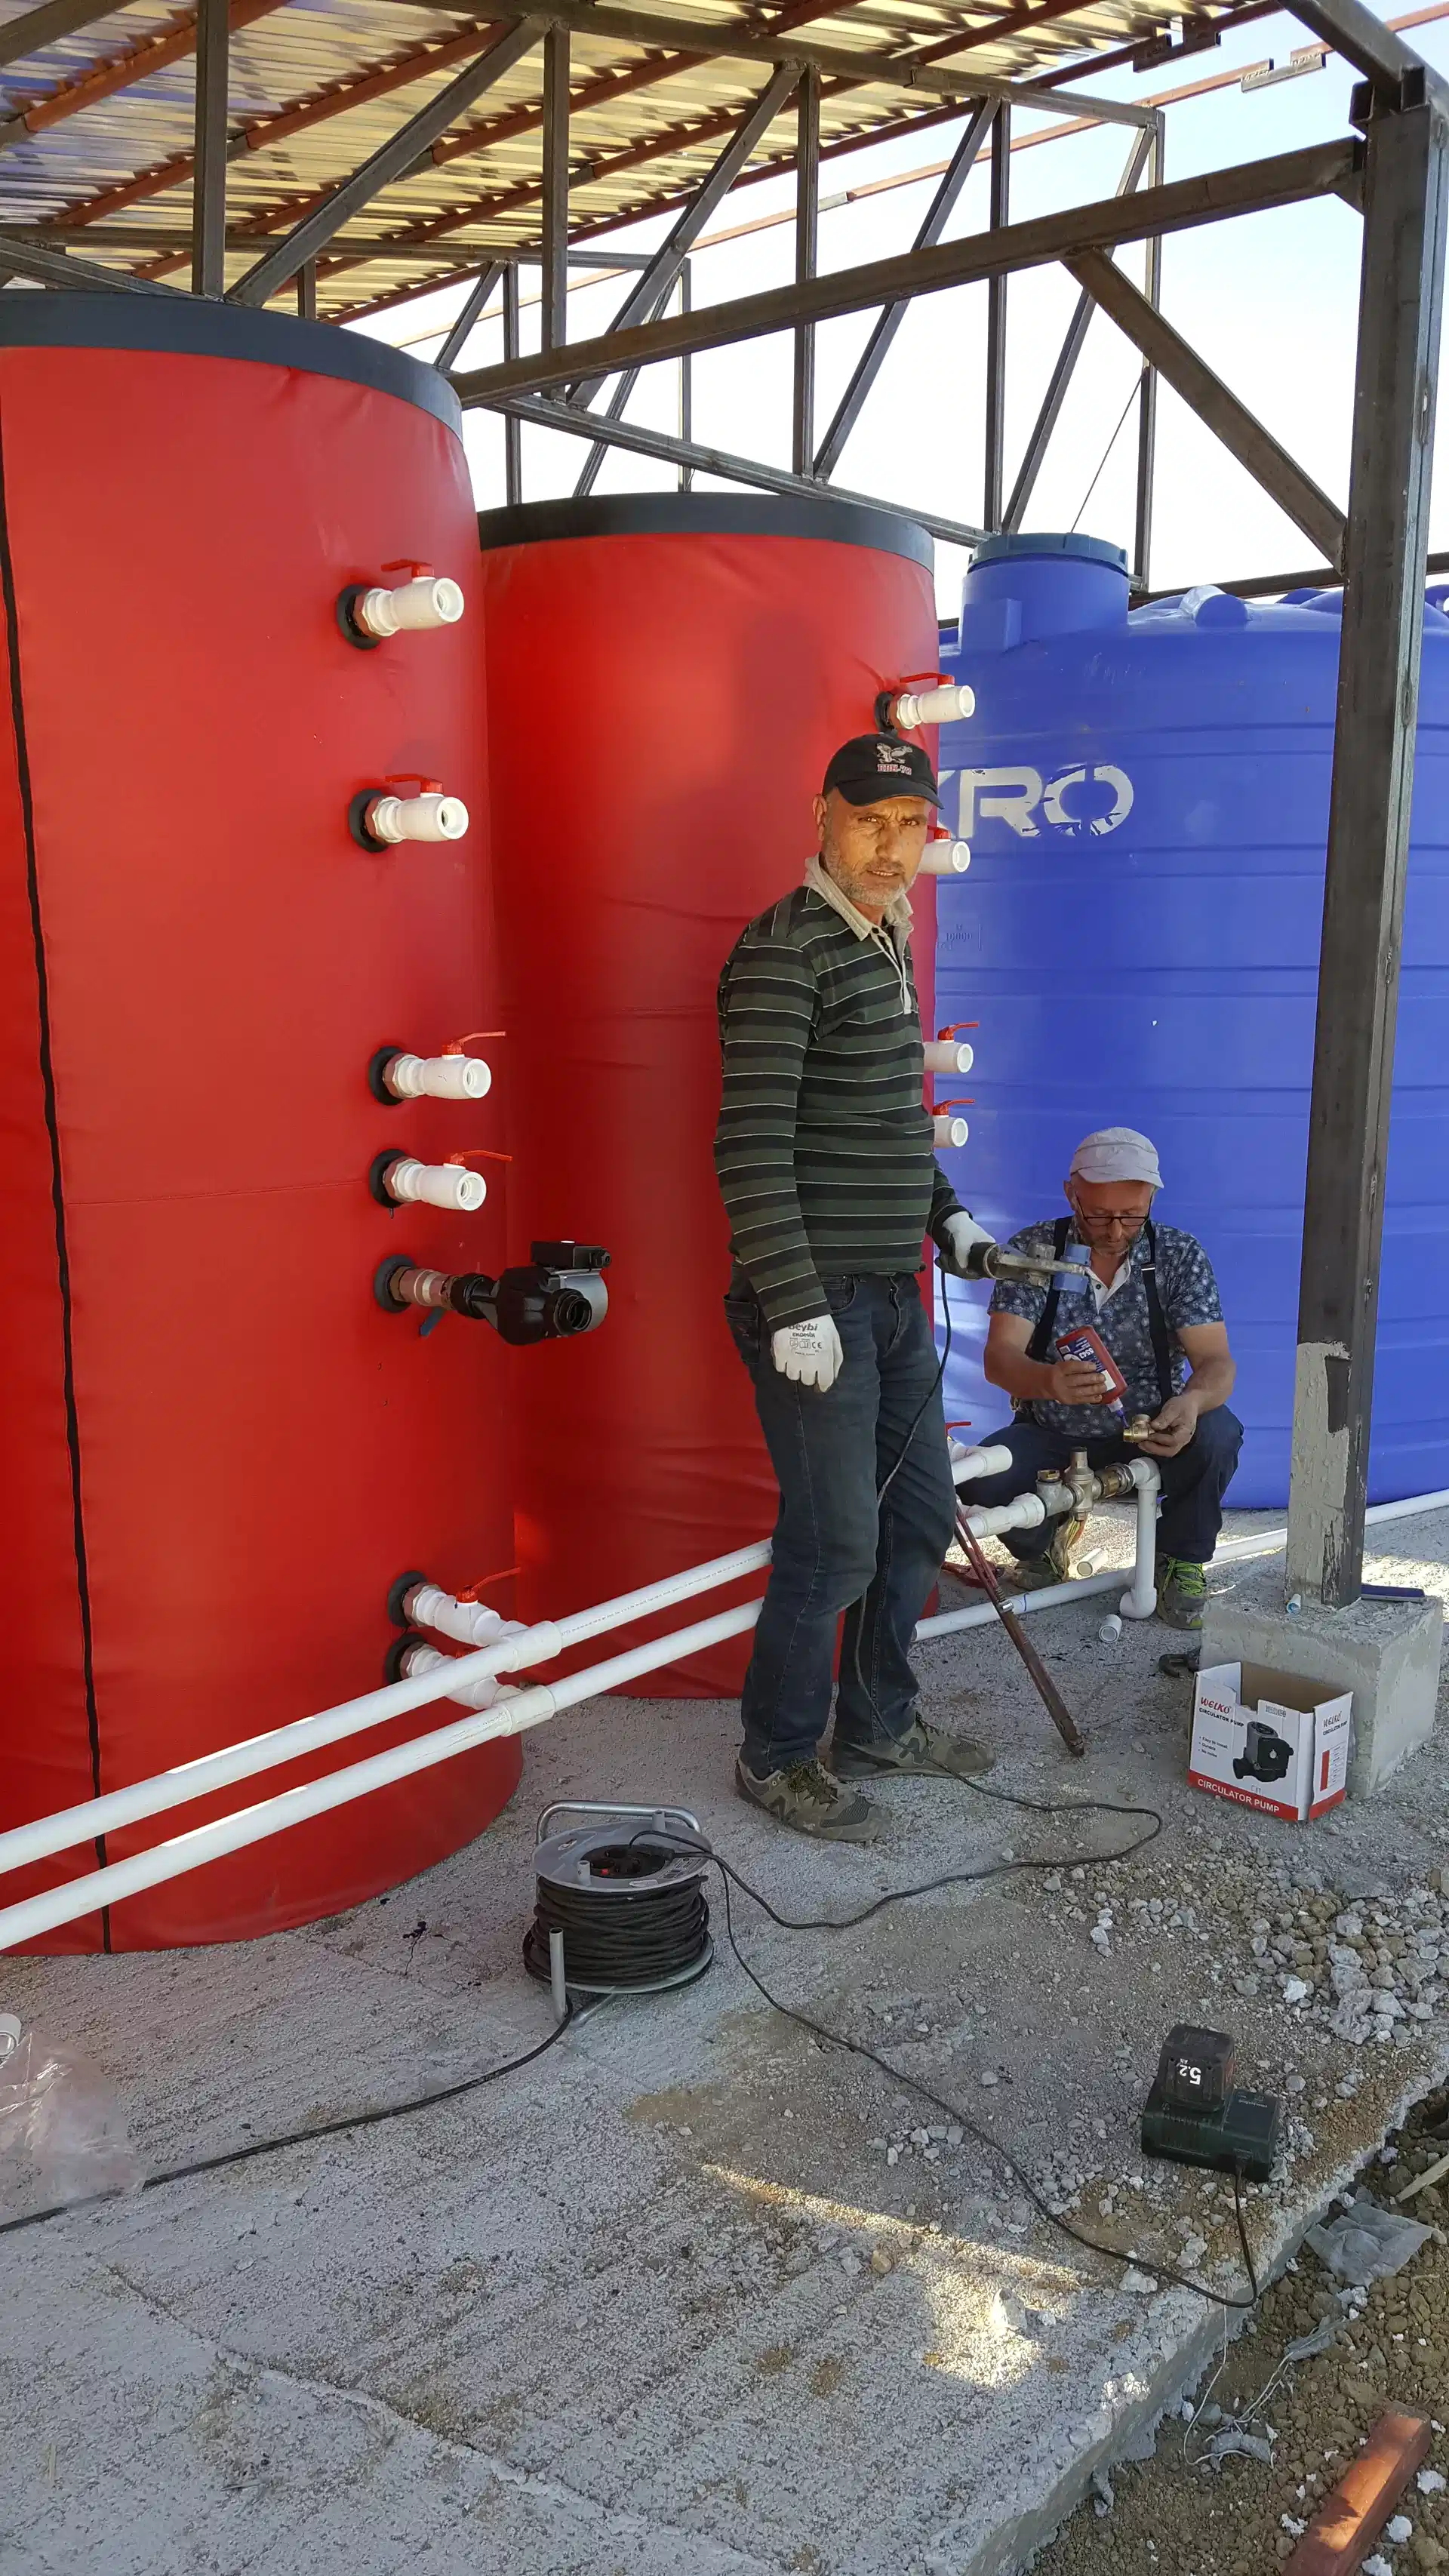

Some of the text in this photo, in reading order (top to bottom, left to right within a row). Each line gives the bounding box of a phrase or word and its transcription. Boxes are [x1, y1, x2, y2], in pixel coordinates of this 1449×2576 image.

[1200, 1697, 1230, 1715] WELKO
[1198, 1707, 1244, 1728] CIRCULATOR PUMP
[1198, 1777, 1253, 1805] CIRCULATOR
[1254, 1799, 1280, 1813] PUMP
[1179, 2064, 1201, 2085] 5.2
